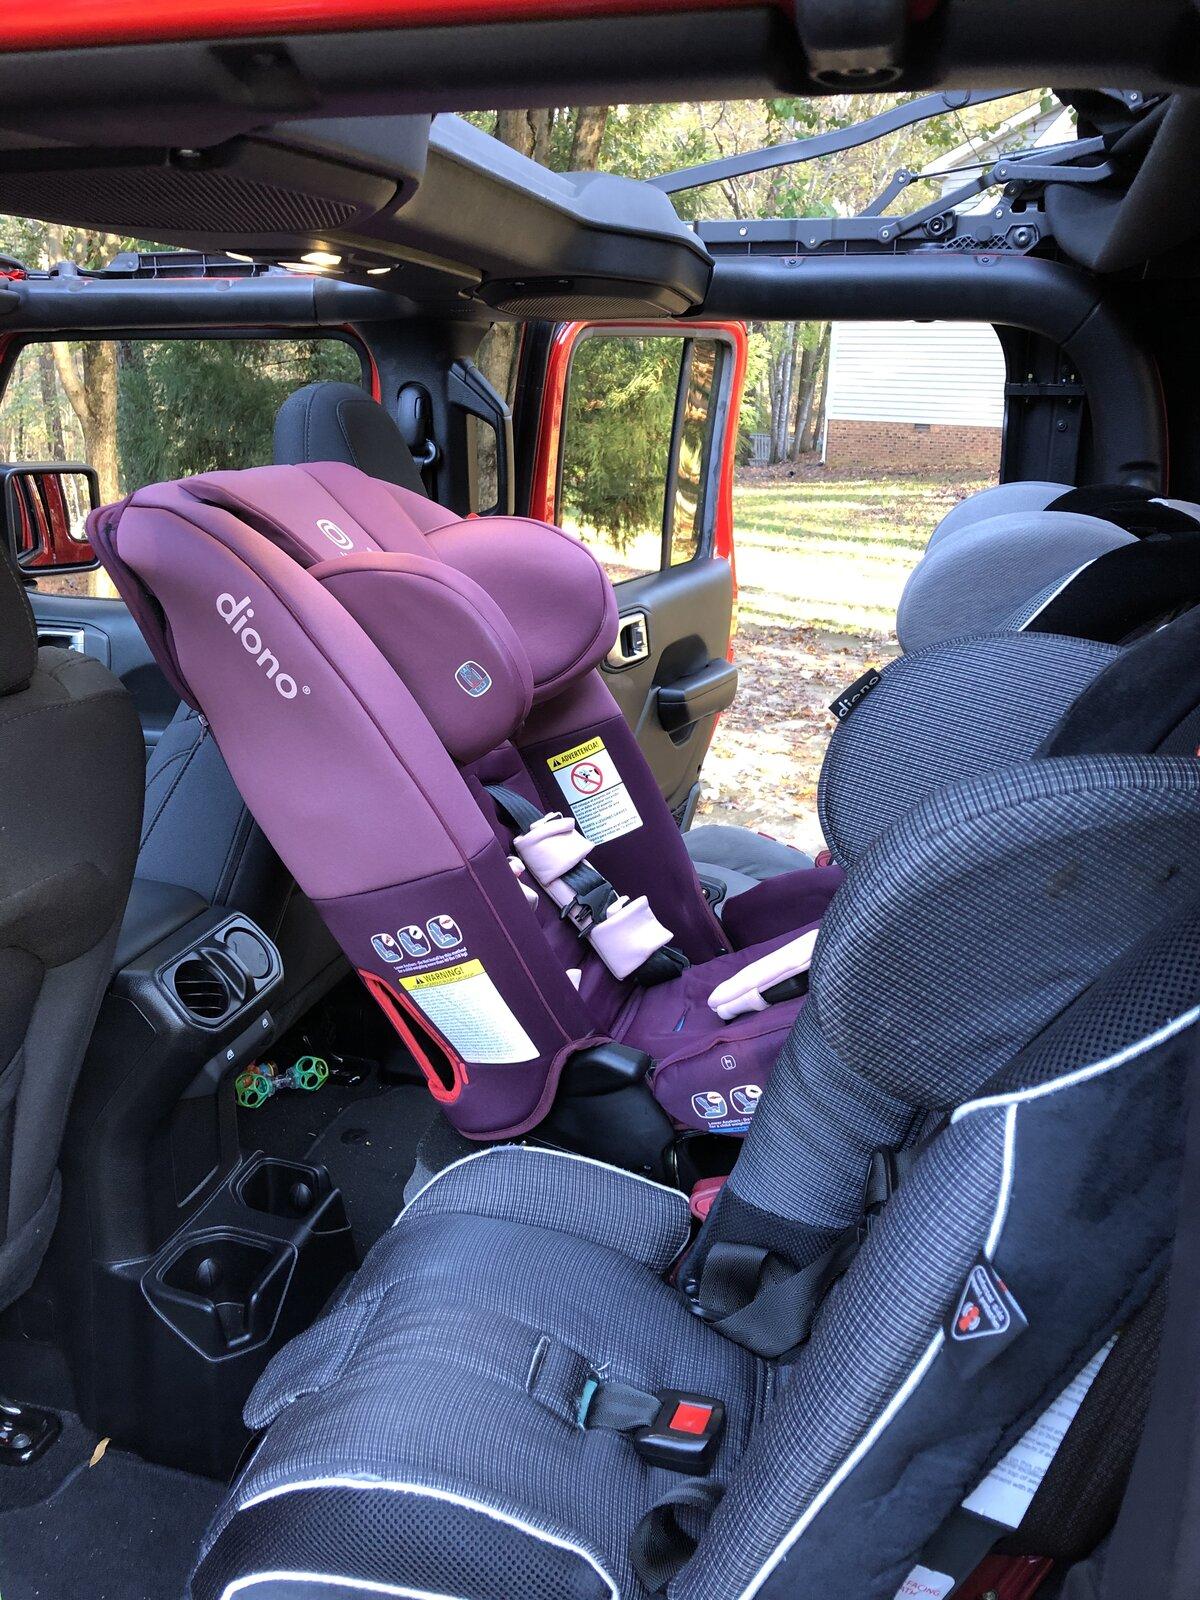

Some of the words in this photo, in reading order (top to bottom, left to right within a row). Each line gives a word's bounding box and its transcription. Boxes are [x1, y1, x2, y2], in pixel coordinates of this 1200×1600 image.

[839, 677, 879, 717] diono
[560, 741, 600, 763] ADVERTENCIA!
[423, 966, 464, 983] WARNING!
